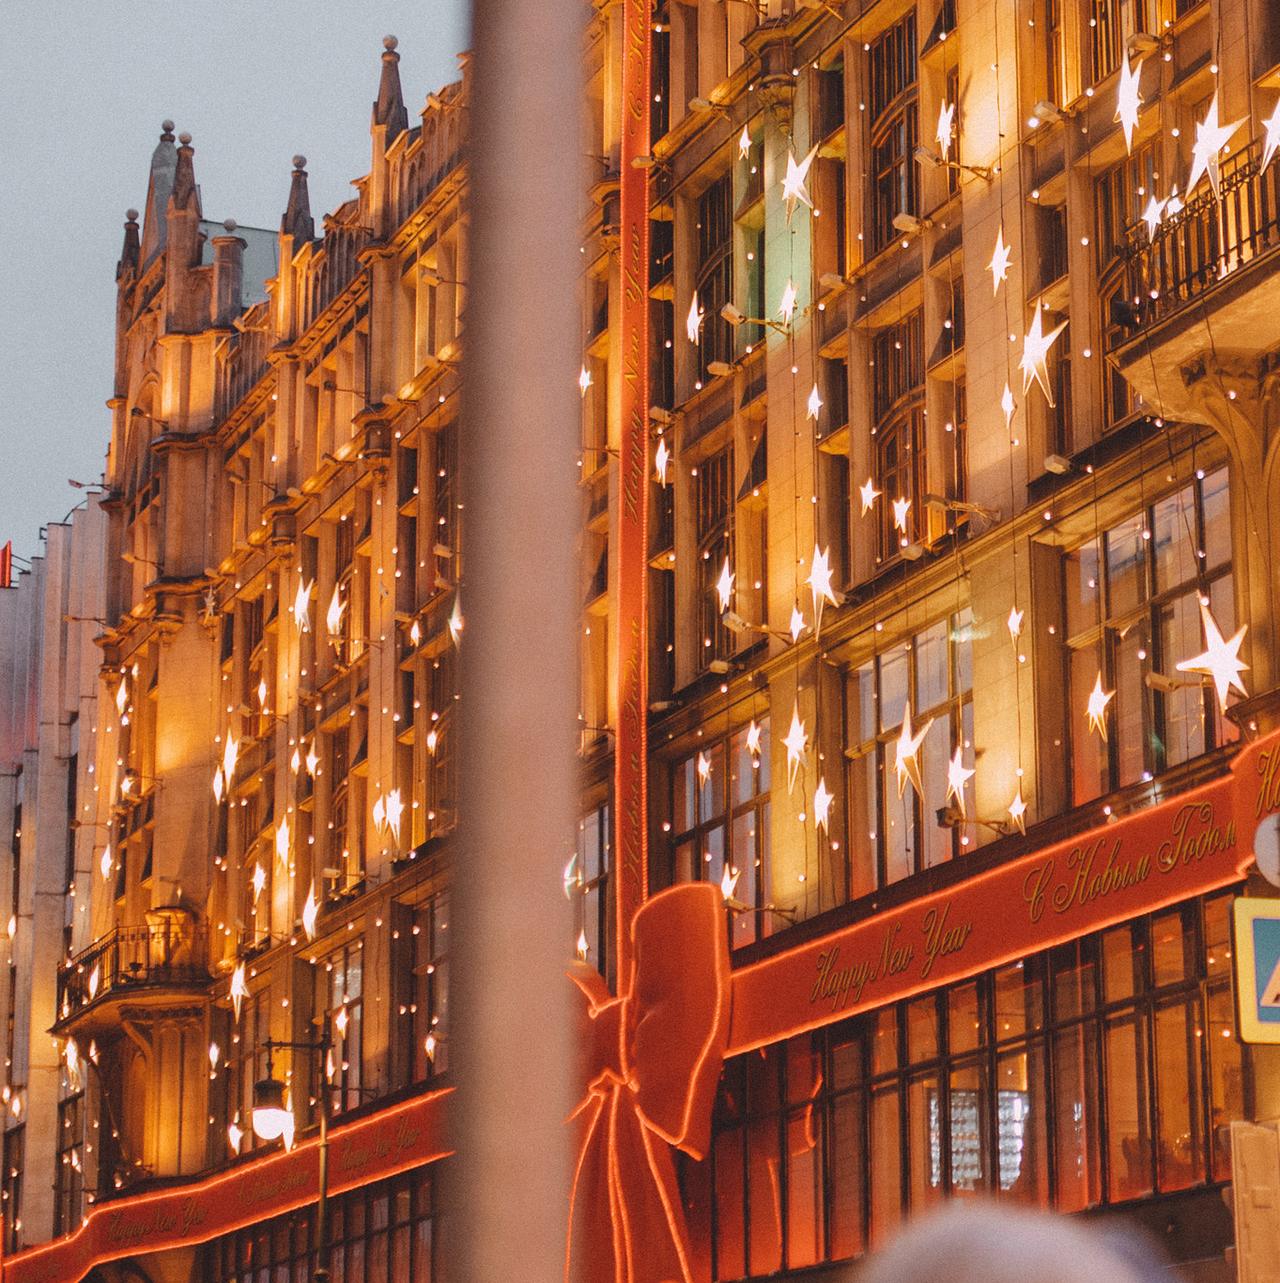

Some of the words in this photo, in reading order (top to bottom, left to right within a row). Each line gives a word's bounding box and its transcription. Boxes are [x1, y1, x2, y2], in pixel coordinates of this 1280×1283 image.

[624, 222, 644, 313] Year
[623, 325, 640, 406] New
[1052, 836, 1152, 914] Новым
[1156, 800, 1237, 874] Годом
[809, 944, 870, 1013] Happy
[867, 921, 915, 982] New
[920, 902, 974, 980] Year
